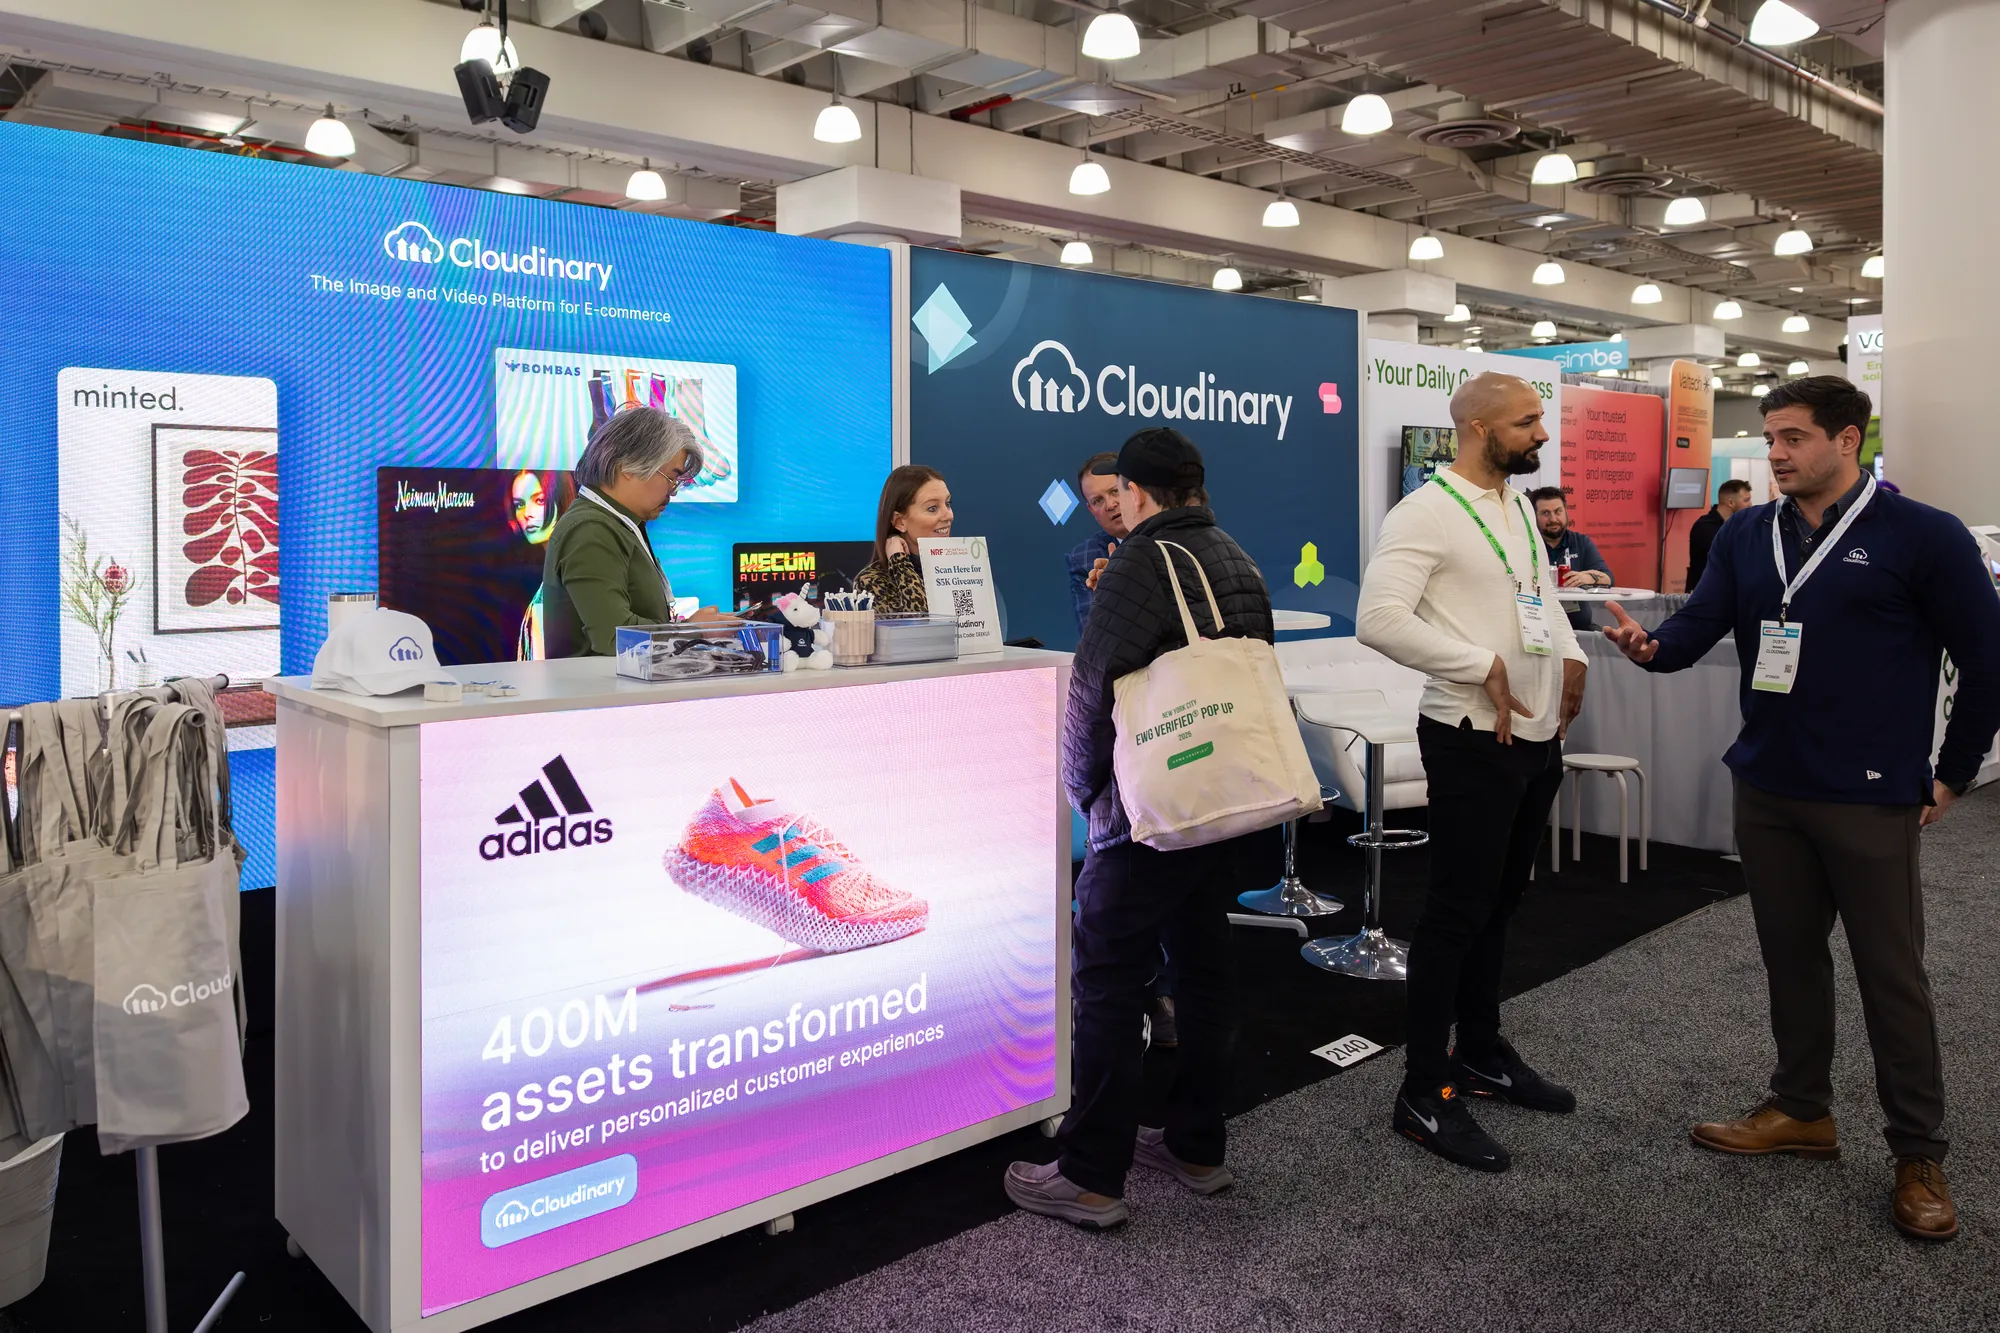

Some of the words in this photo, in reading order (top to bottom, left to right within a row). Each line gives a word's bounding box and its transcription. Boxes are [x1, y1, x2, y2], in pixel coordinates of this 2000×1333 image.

[450, 238, 613, 290] Cloudinary
[310, 274, 343, 292] The
[350, 278, 401, 298] Image
[407, 285, 437, 301] and
[442, 288, 487, 306] Video
[493, 293, 555, 313] Platform
[559, 299, 580, 314] for
[584, 302, 671, 323] E-commerce
[1553, 348, 1623, 369] simbe
[522, 363, 581, 377] BOMBAS
[1375, 358, 1412, 386] Your
[1417, 363, 1455, 396] Daily
[1679, 372, 1702, 392] Valtech
[74, 384, 184, 411] minted.
[1096, 364, 1293, 440] Cloudinary
[1586, 407, 1601, 421] Your
[1602, 410, 1627, 424] trusted
[1586, 446, 1637, 463] implementation
[1586, 467, 1599, 480] and
[1601, 468, 1634, 484] integration
[395, 480, 436, 512] Neiman
[434, 480, 475, 512] Marcus
[1586, 489, 1610, 503] agency
[1611, 488, 1634, 503] partner
[740, 551, 816, 572] MECUM
[934, 566, 952, 574] Scan
[953, 565, 970, 573] Here
[971, 565, 981, 573] for
[1842, 557, 1870, 566] Cloudinary
[740, 571, 816, 582] AUCTIONS
[936, 578, 951, 586] $5K
[952, 577, 983, 586] Giveaway
[1162, 710, 1173, 719] NEW
[1173, 704, 1187, 715] YORK
[1186, 699, 1197, 710] CITY
[1135, 728, 1154, 746] EWG
[1200, 703, 1219, 719] POP
[1221, 702, 1234, 714] UP
[479, 816, 613, 861] adidas
[170, 964, 232, 1007] Cloud
[481, 987, 639, 1066] 400M
[481, 1050, 654, 1132] assets
[668, 972, 928, 1078] transformed
[1325, 1039, 1370, 1061] 2140
[479, 1151, 505, 1173] to
[513, 1123, 595, 1164] deliver
[600, 1080, 738, 1144] personalized
[744, 1054, 835, 1096] customer
[839, 1022, 945, 1067] experiences
[531, 1176, 625, 1217] Cloudinary
